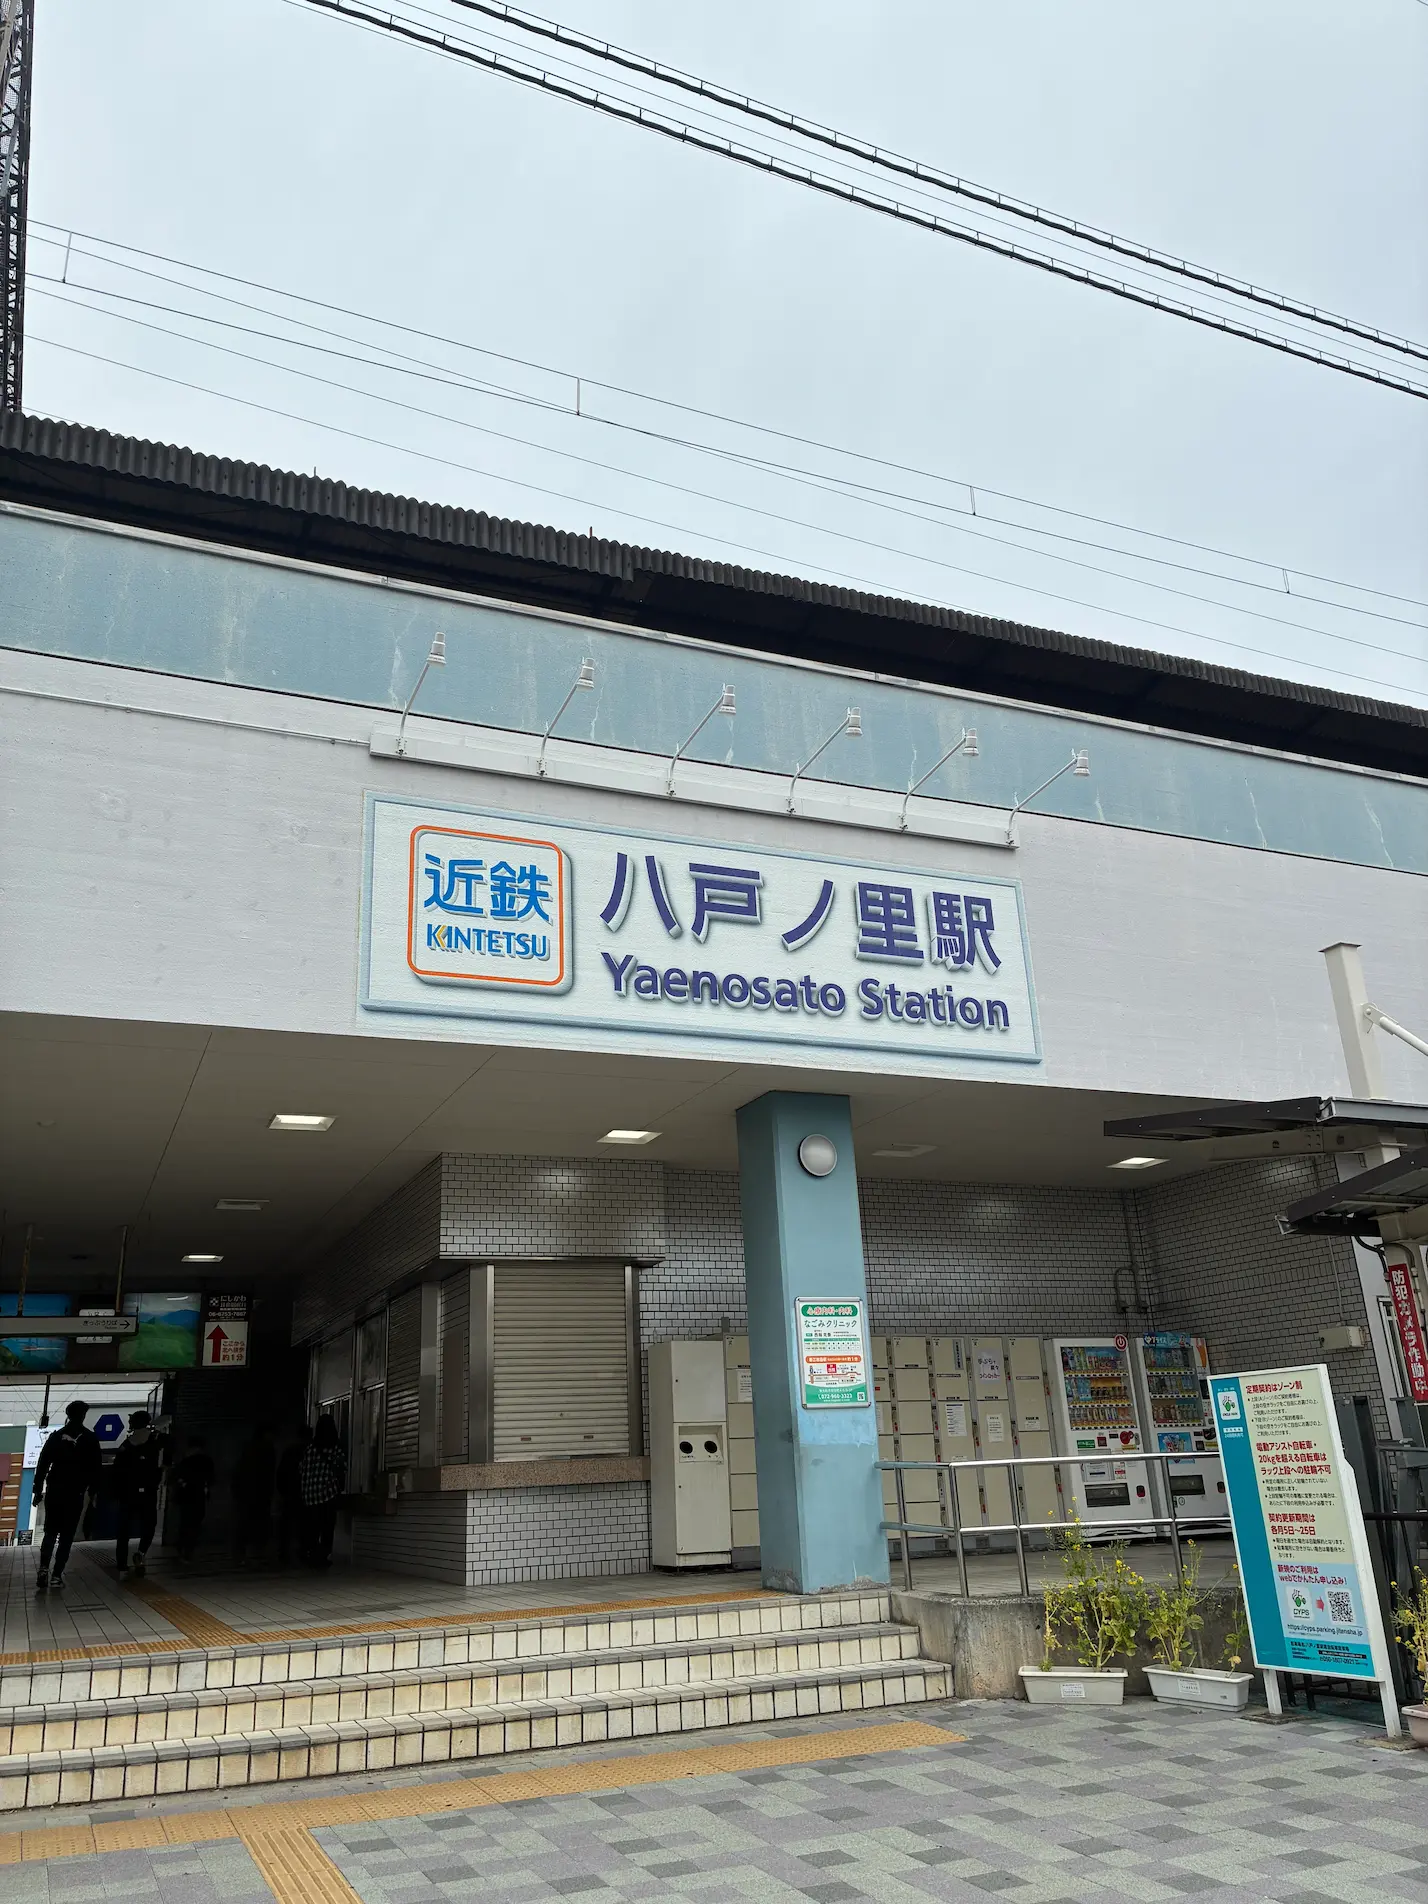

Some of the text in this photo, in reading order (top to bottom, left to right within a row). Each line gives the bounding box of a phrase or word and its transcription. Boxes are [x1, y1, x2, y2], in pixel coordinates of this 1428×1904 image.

[423, 853, 551, 923] 近鉄
[599, 851, 1003, 970] 八戸ノ里駅
[426, 923, 549, 960] KINTETSU
[601, 952, 1011, 1030] Yaenosato Station
[804, 1319, 857, 1329] なごみクリニック
[1391, 1269, 1428, 1394] 防犯カメラ作動中
[1245, 1380, 1303, 1394] 定期契約はゾーン制
[1258, 1452, 1327, 1465] 20kgを超える自転車は
[1260, 1464, 1332, 1476] ラック上段への駐輪不可
[1268, 1513, 1316, 1523] 契約更新期間は
[1277, 1564, 1319, 1575] 新規のご利用は
[1293, 1608, 1310, 1616] CYPS
